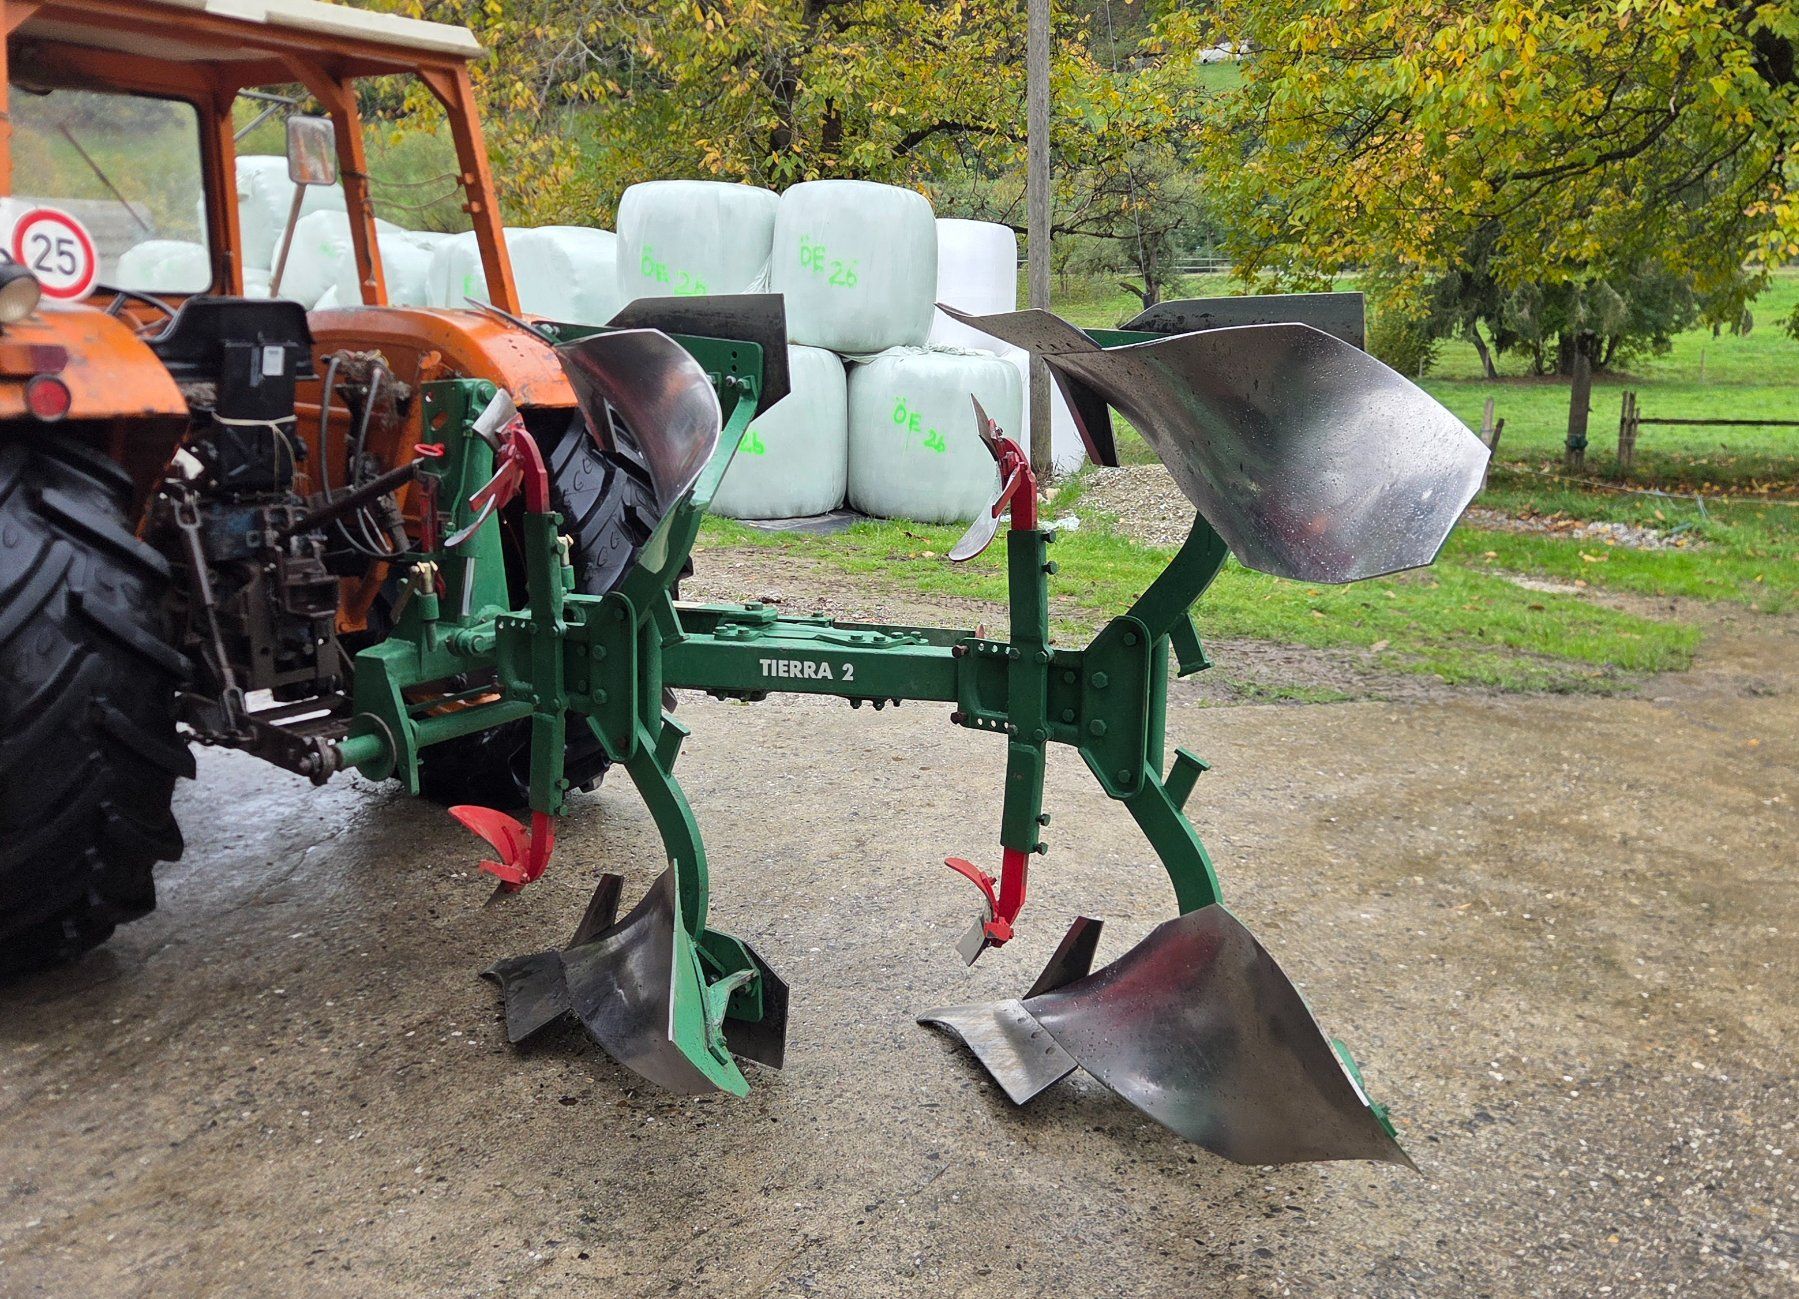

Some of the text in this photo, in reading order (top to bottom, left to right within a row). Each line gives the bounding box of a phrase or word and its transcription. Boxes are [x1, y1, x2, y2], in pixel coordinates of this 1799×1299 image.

[31, 233, 77, 276] 25
[829, 259, 859, 288] 26
[893, 395, 947, 454] ÖE 26
[759, 658, 854, 681] TIERRA 2
